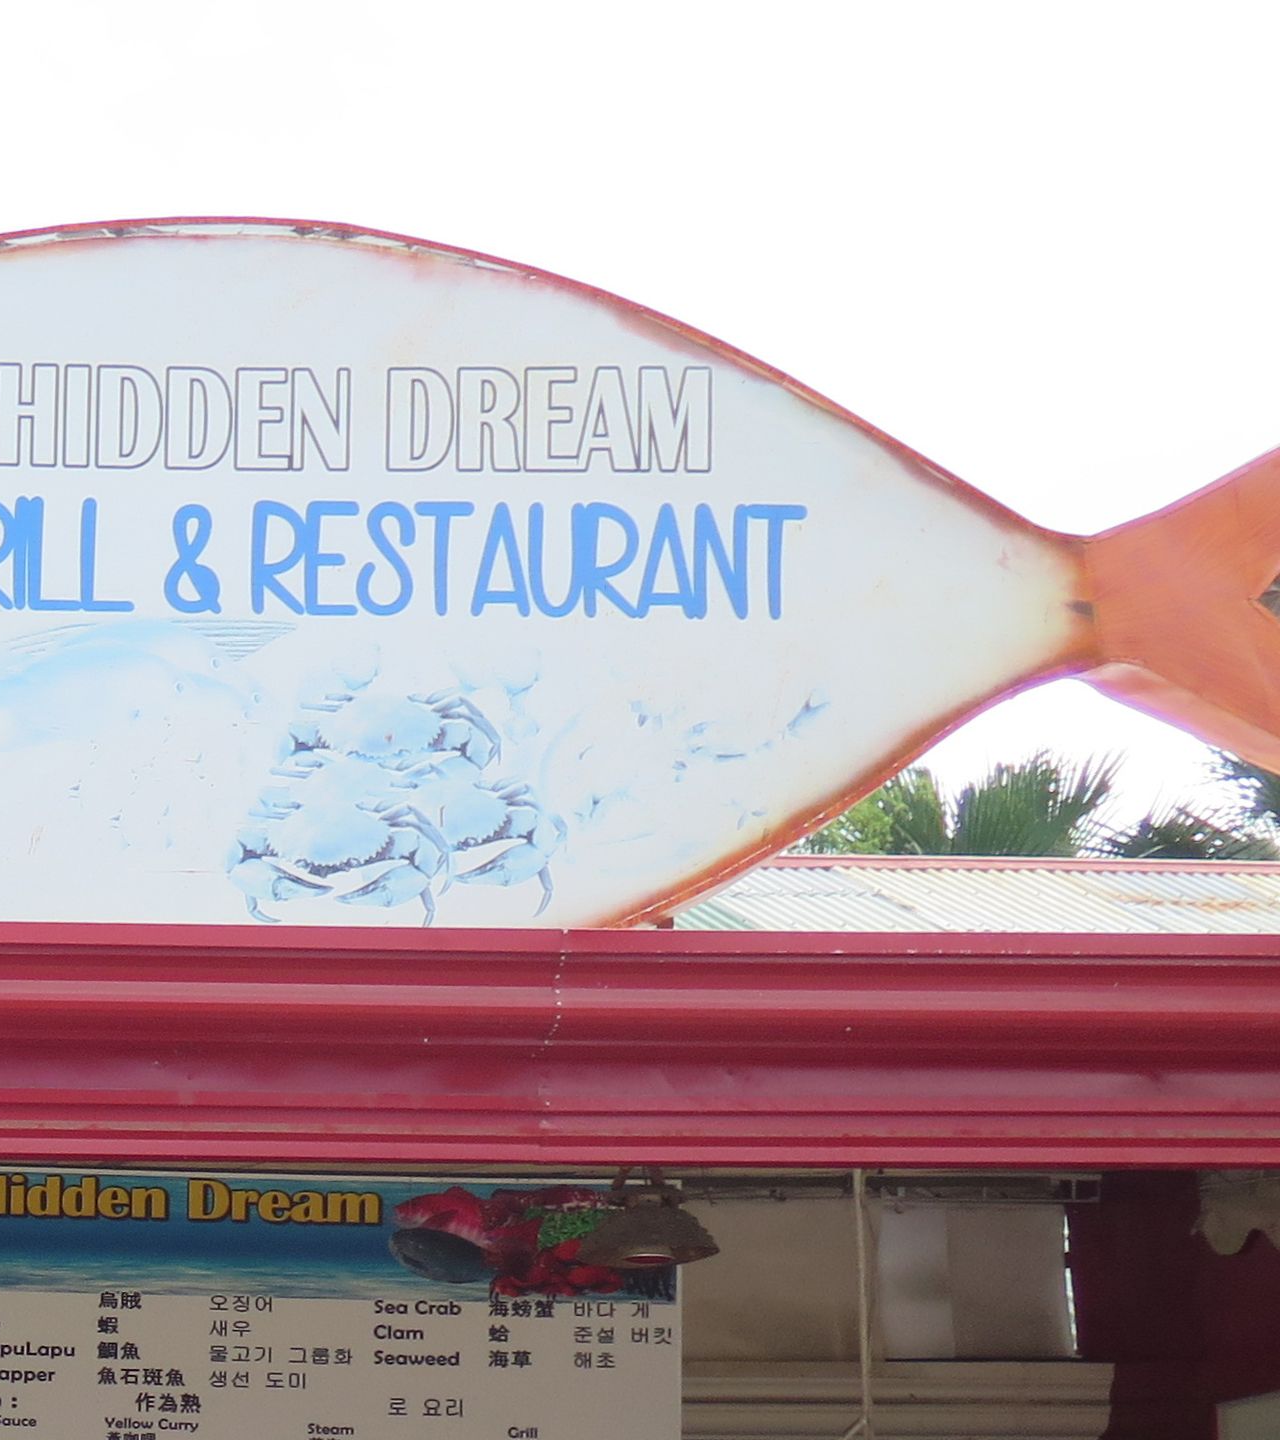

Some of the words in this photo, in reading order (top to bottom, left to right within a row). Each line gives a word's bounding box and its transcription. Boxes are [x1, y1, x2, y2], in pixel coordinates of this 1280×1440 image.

[386, 366, 712, 473] DREAM
[163, 504, 222, 614] &
[250, 500, 808, 620] RESTAURANT
[188, 1178, 381, 1224] Dream
[209, 1294, 273, 1313] 오징어
[373, 1300, 408, 1316] Sea
[414, 1300, 462, 1316] Crab
[573, 1301, 616, 1319] 바다
[631, 1301, 650, 1318] 게
[209, 1320, 252, 1337] 새우
[373, 1324, 424, 1341] Clam
[209, 1345, 272, 1363] 물고기
[373, 1350, 460, 1366] Seaweed
[488, 1350, 532, 1369] 海草
[574, 1351, 616, 1368] 해초
[208, 1370, 250, 1388] 생선
[265, 1372, 306, 1389] 도미
[388, 1397, 408, 1416] 로
[422, 1398, 464, 1417] 요리
[104, 1416, 153, 1430] Yellow
[158, 1418, 199, 1433] Curry
[307, 1422, 354, 1436] Steam
[508, 1426, 538, 1439] Grill
